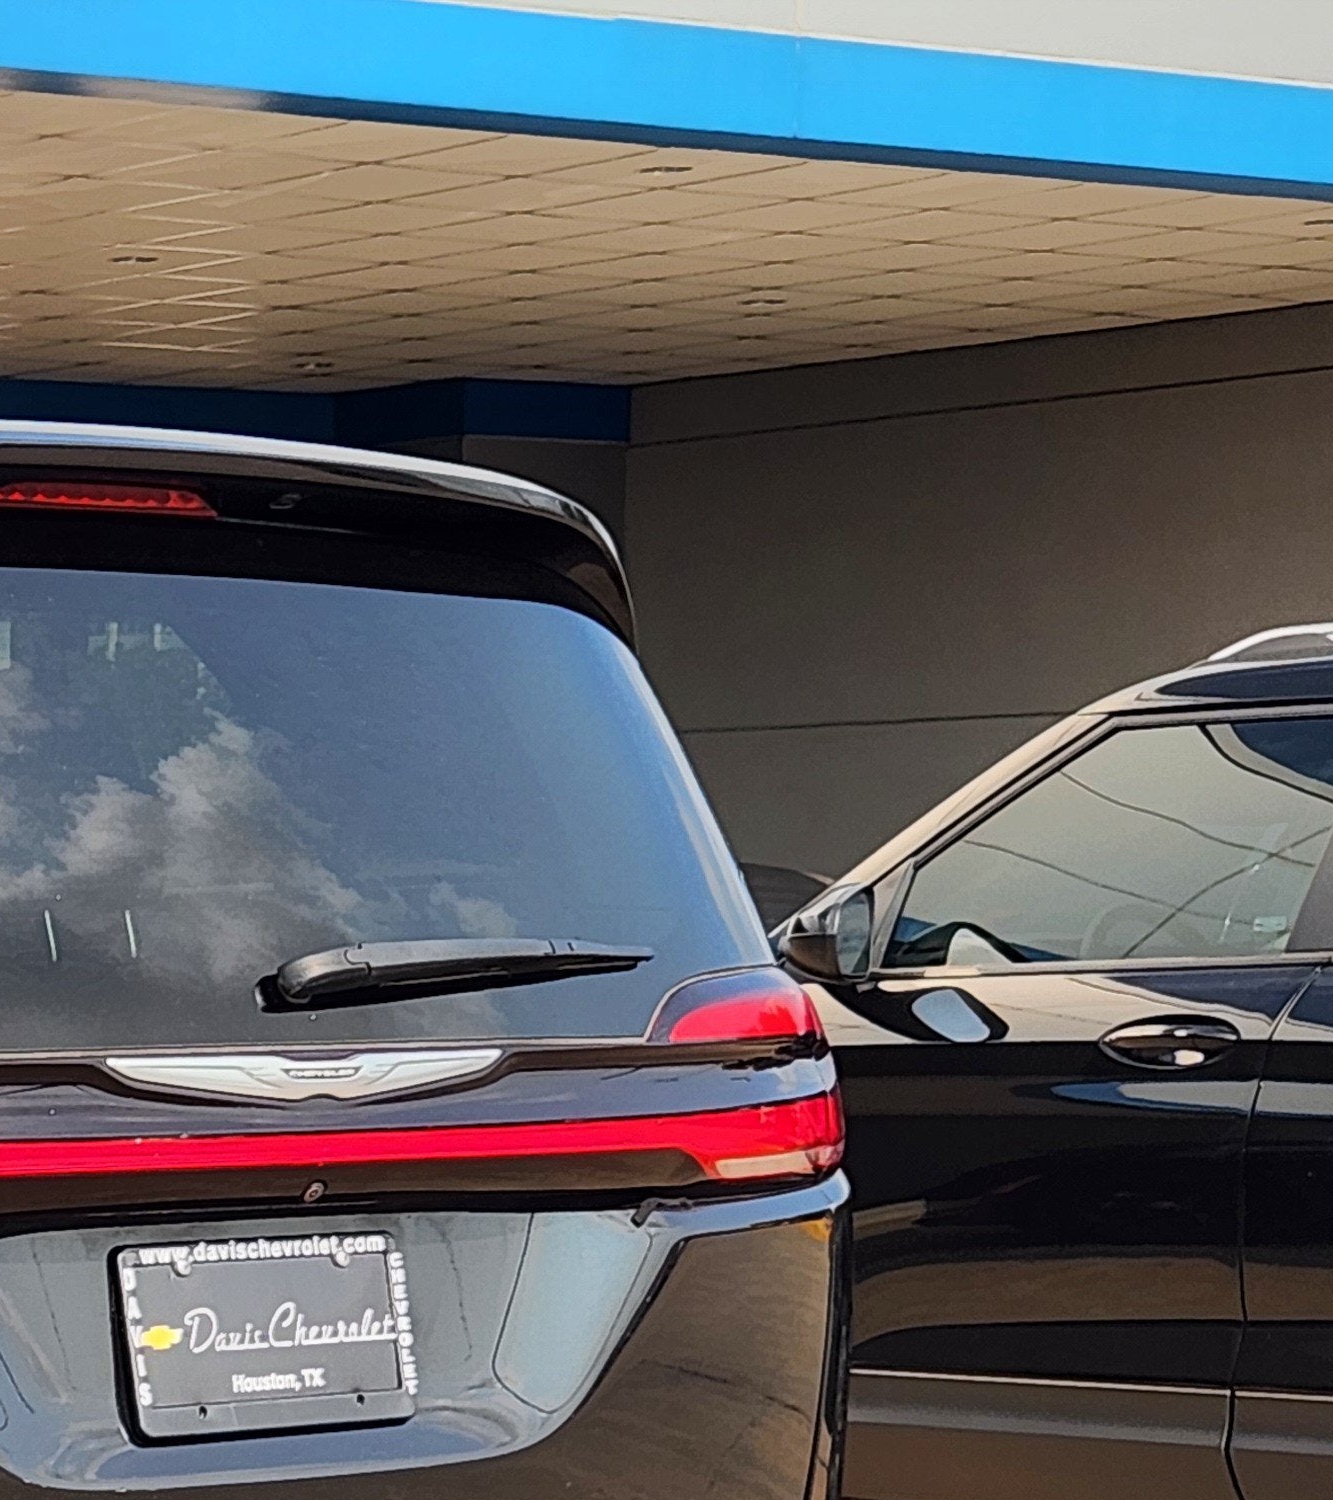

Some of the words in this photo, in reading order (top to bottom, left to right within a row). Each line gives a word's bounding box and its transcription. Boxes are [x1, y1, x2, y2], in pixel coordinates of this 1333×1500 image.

[137, 1234, 386, 1265] www.davischevrolet.com
[123, 1267, 153, 1407] DAVIS
[183, 1306, 270, 1355] Davis
[269, 1301, 398, 1349] Chevrolet
[388, 1251, 419, 1396] CHEVROLET
[231, 1369, 301, 1394] Houston,
[301, 1367, 326, 1389] TX
